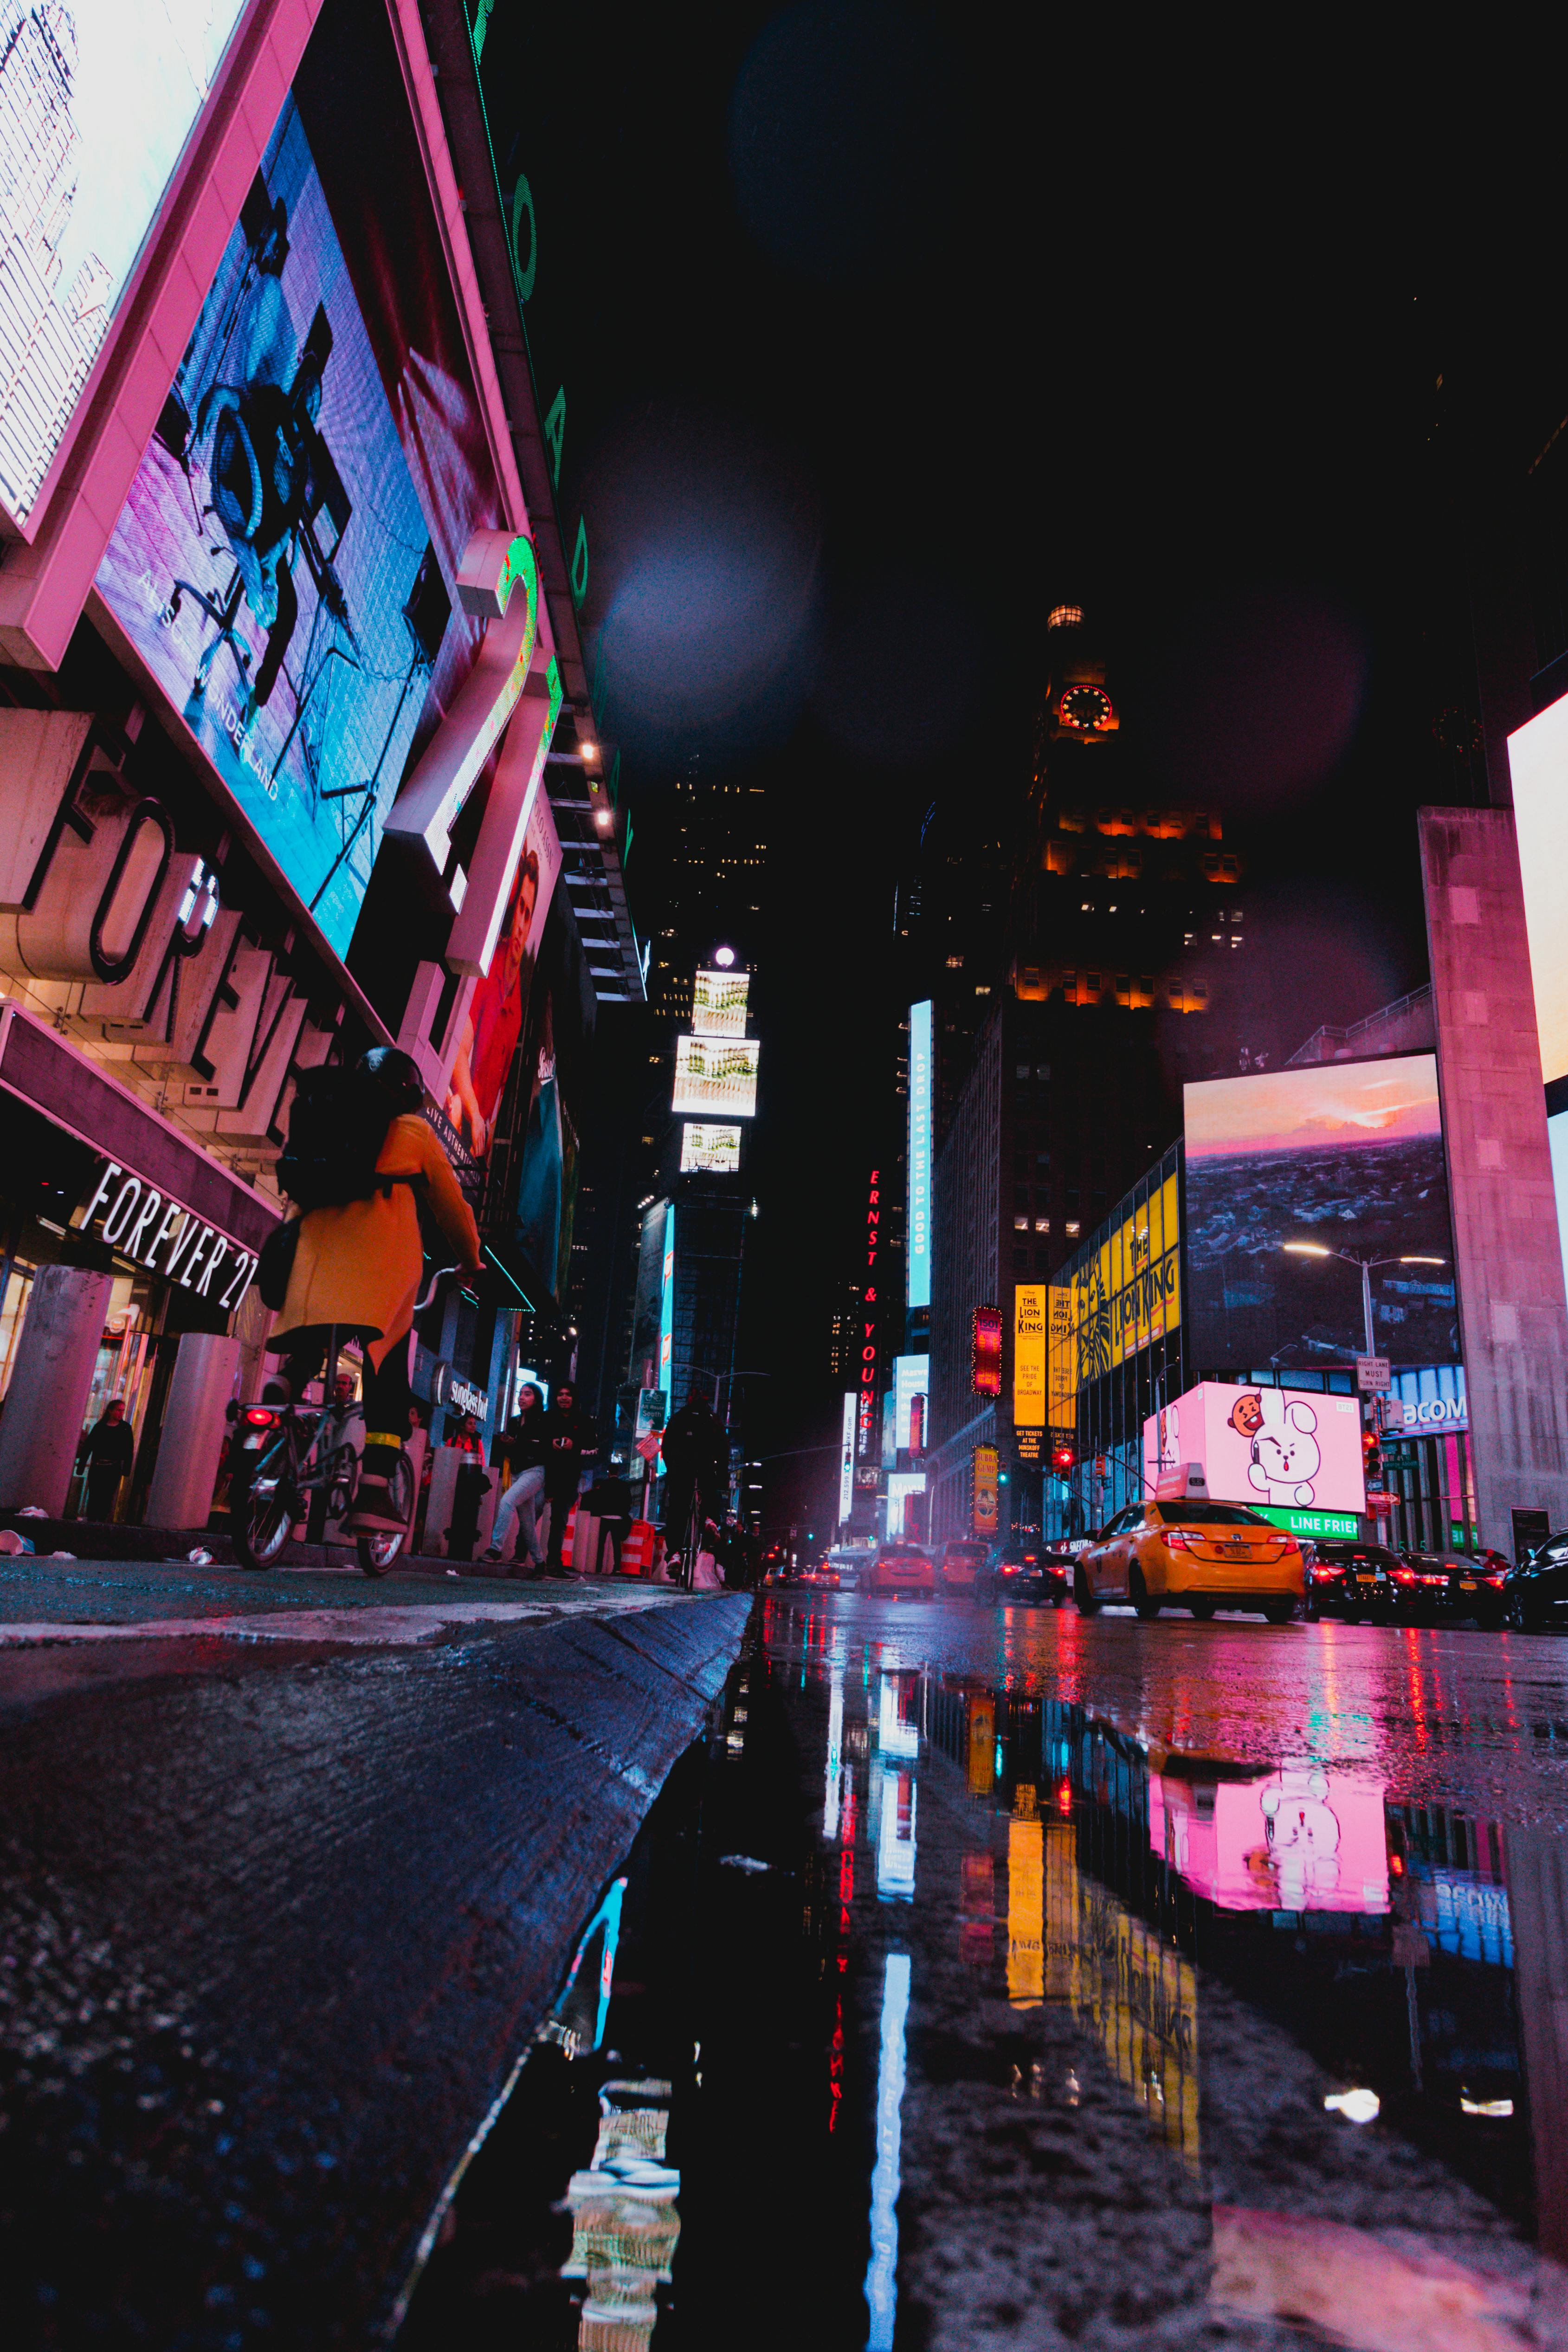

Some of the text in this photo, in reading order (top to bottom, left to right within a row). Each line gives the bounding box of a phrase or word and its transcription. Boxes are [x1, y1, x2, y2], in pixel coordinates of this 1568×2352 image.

[915, 1053, 925, 1254] GOOD TO THE LAST DROP
[79, 1162, 259, 1312] FOREVER 21
[1130, 1237, 1148, 1266] THE
[860, 1170, 880, 1430] ERNST & YOUNG
[1142, 1259, 1174, 1327] KING
[1020, 1306, 1040, 1318] LION
[979, 1318, 998, 1329] 1501
[1018, 1319, 1043, 1334] KING
[451, 1381, 489, 1422] sunglass hut
[976, 1451, 997, 1463] BUBBA
[977, 1463, 995, 1474] GUMP
[1291, 1516, 1321, 1530] LINE
